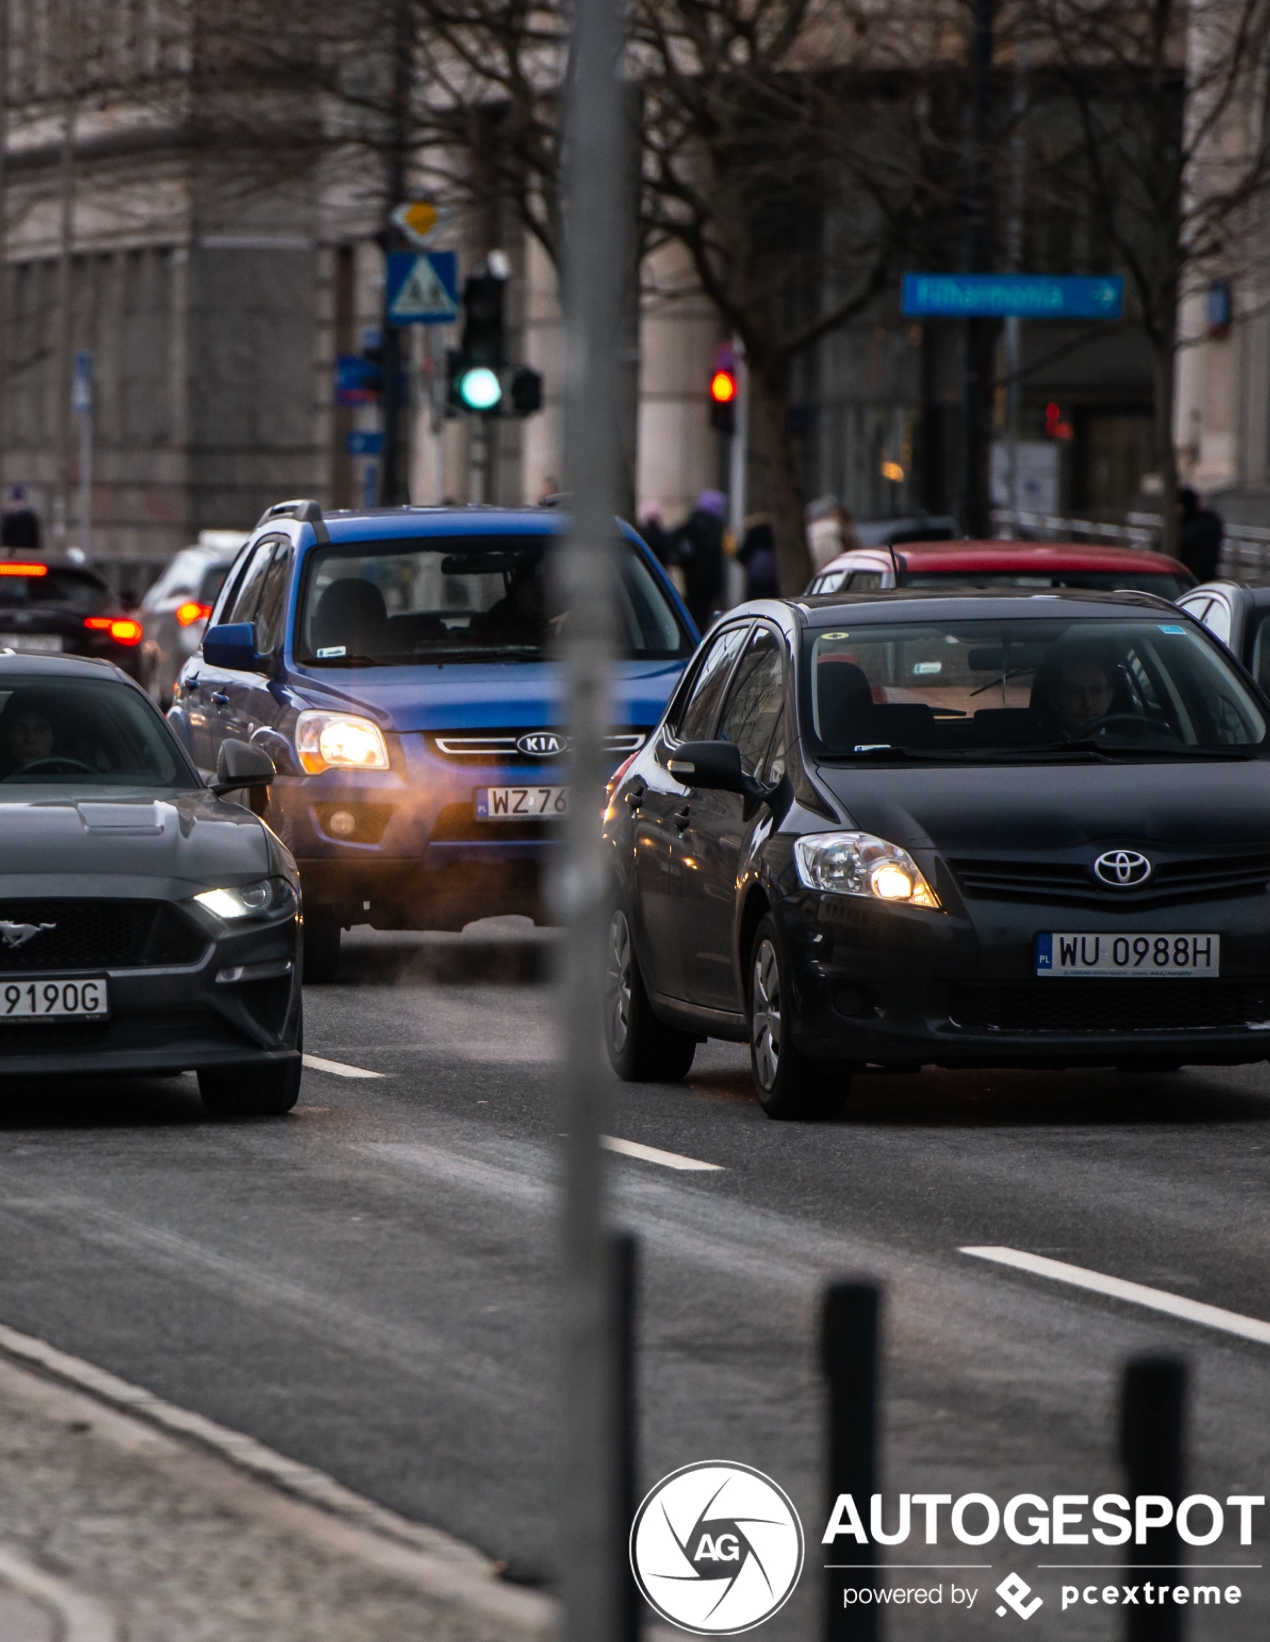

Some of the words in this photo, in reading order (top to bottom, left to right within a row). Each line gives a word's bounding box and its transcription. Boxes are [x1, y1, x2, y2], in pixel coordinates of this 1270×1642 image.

[916, 277, 1064, 309] Filharmonia
[526, 737, 559, 751] KIA
[493, 789, 529, 814] WZ
[1039, 955, 1050, 964] PL
[1060, 936, 1100, 967] WU
[1113, 937, 1211, 967] 0988H
[4, 983, 99, 1014] 9190G
